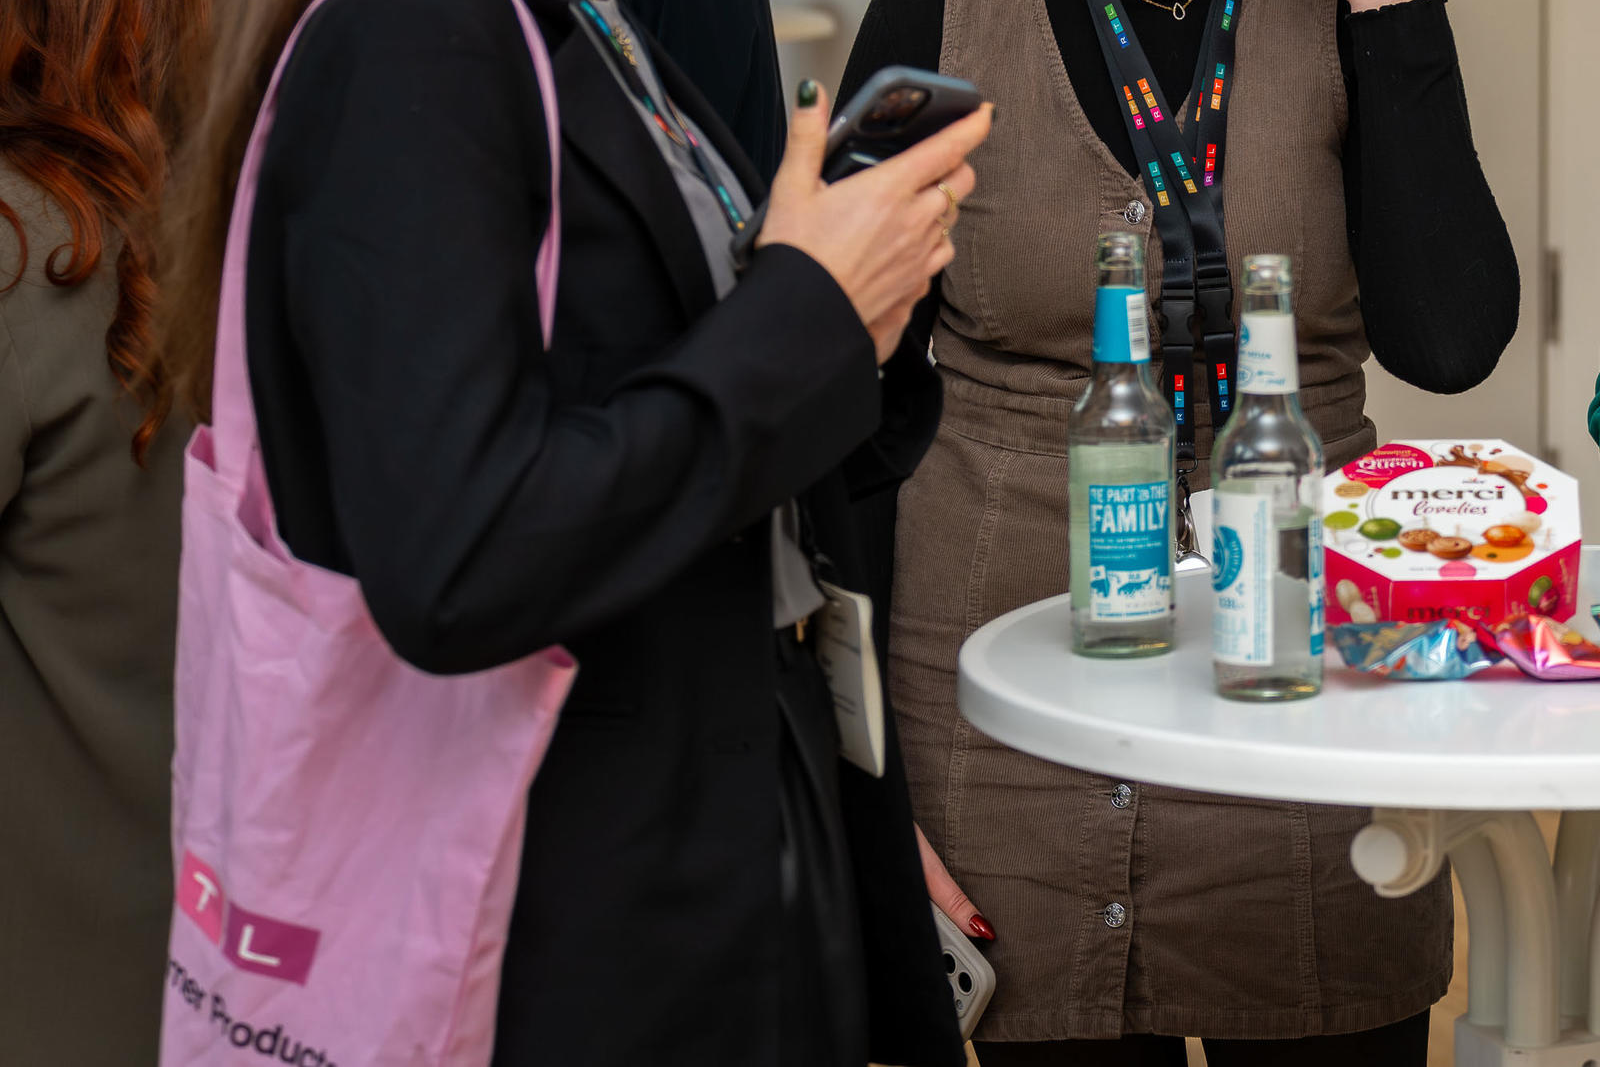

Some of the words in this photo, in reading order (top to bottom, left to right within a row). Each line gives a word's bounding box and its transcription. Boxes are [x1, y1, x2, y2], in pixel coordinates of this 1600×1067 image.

[1108, 7, 1128, 46] RTL
[1141, 81, 1161, 120] RTL
[1212, 67, 1224, 107] RTL
[1152, 165, 1167, 203] RTL
[1175, 155, 1195, 191] RTL
[1205, 147, 1215, 184] RTL
[1176, 378, 1184, 422] RTL
[1219, 367, 1228, 408] RTL
[1106, 487, 1135, 503] PART
[1391, 486, 1505, 500] merci
[1413, 500, 1488, 516] lovelies
[1090, 501, 1167, 533] FAMILY
[1407, 605, 1490, 620] merci
[210, 992, 338, 1067] Product
